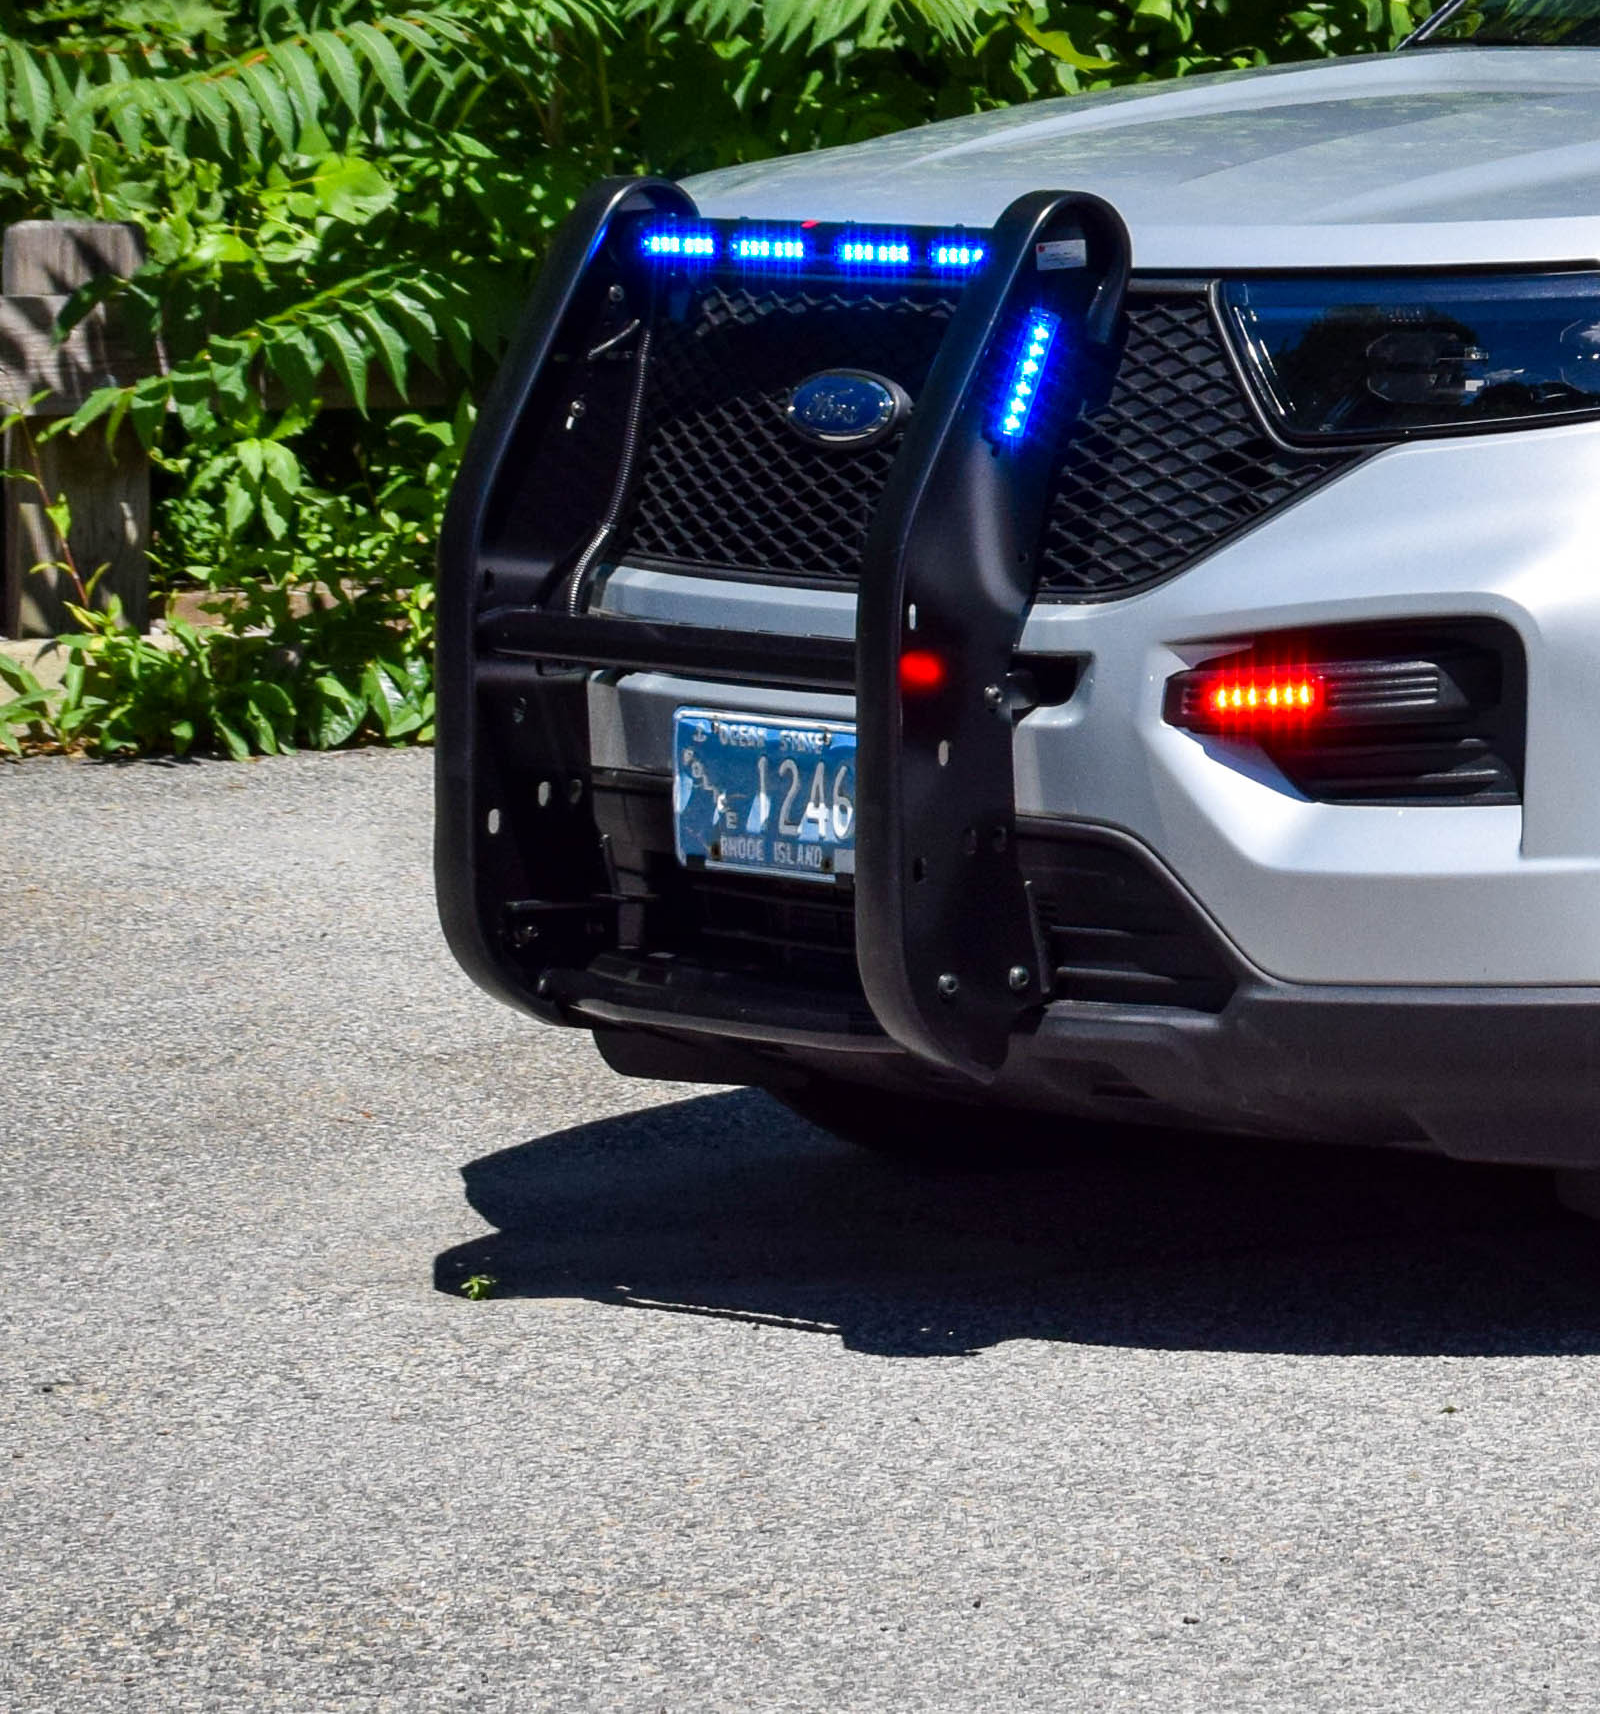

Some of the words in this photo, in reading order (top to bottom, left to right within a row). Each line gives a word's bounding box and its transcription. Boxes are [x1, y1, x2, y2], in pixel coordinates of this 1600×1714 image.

[719, 722, 768, 748] OCEAN
[778, 729, 824, 755] STATE
[757, 754, 854, 840] 1246
[720, 835, 764, 862] RHODE
[773, 840, 822, 868] ISLAND
